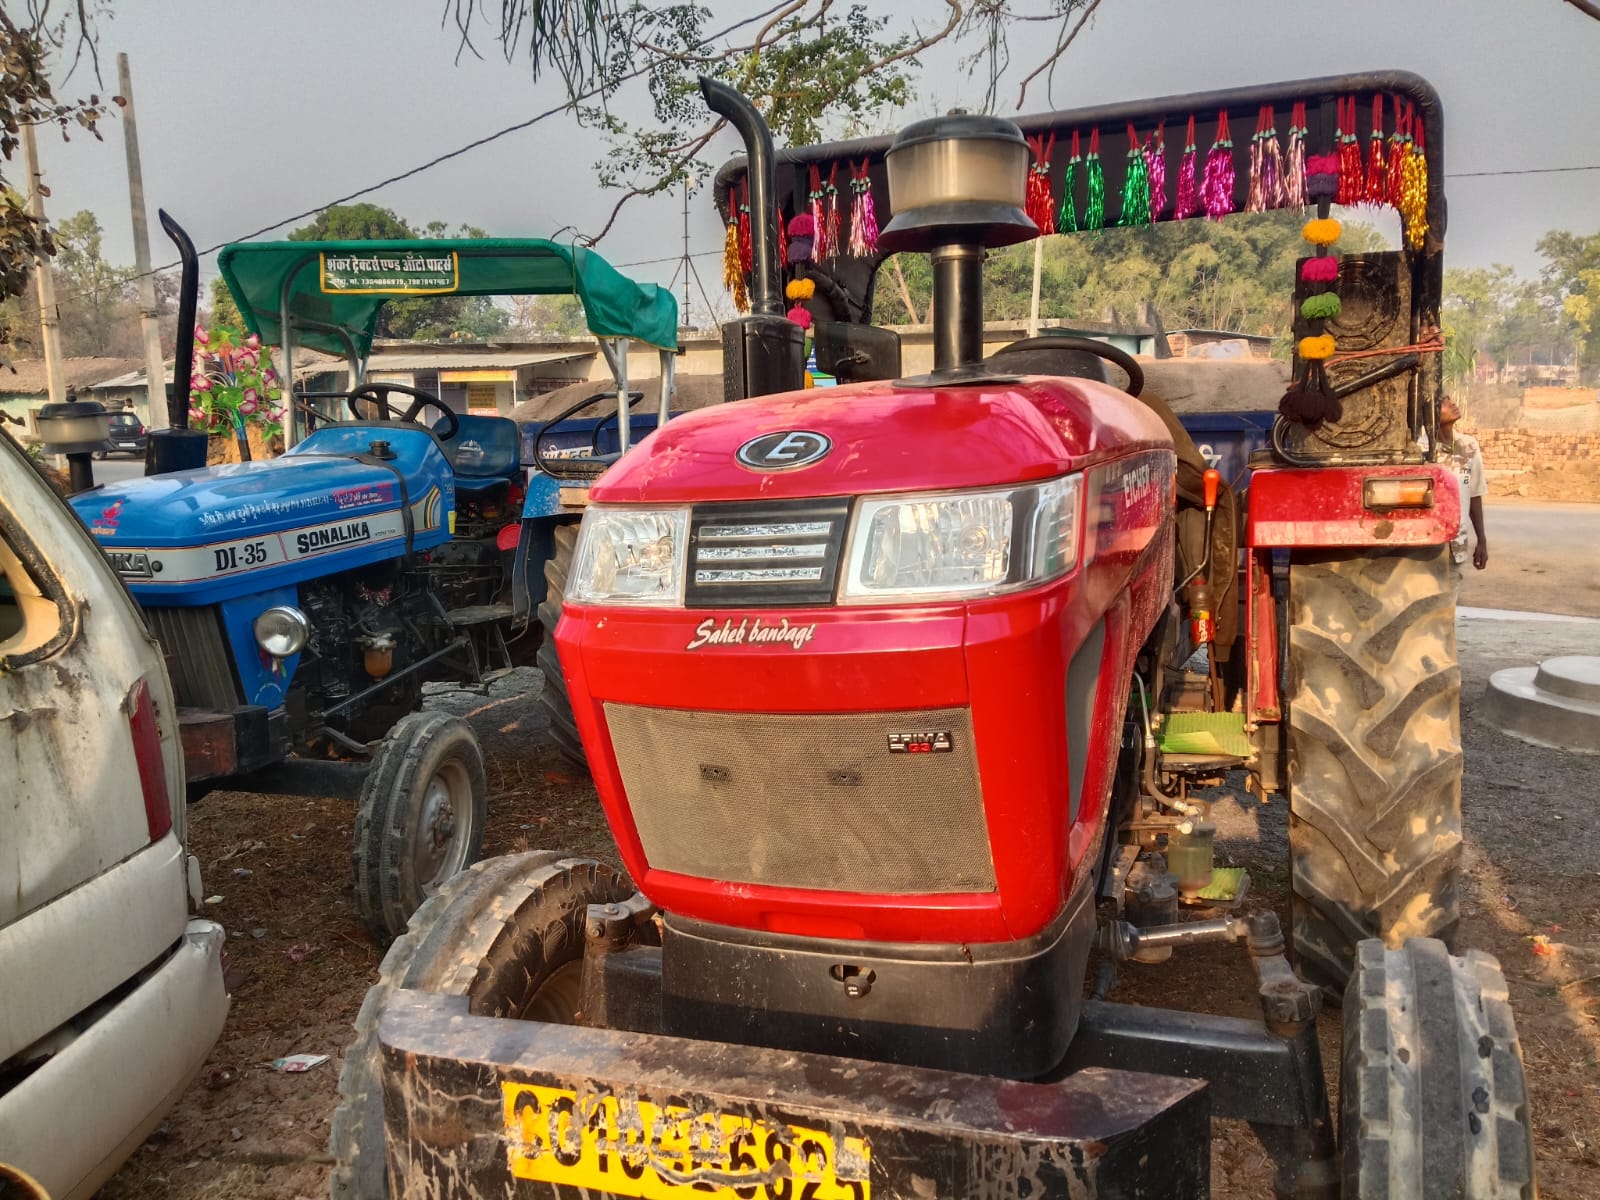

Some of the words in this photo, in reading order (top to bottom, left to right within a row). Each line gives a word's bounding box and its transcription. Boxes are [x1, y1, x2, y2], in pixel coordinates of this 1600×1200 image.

[327, 254, 351, 272] शंकर
[380, 258, 401, 272] एण्ड
[402, 255, 426, 272] ऑटो
[297, 522, 371, 554] SONALIKA
[214, 541, 267, 572] DI-35
[687, 618, 747, 650] Saheb
[748, 618, 816, 650] bandagi
